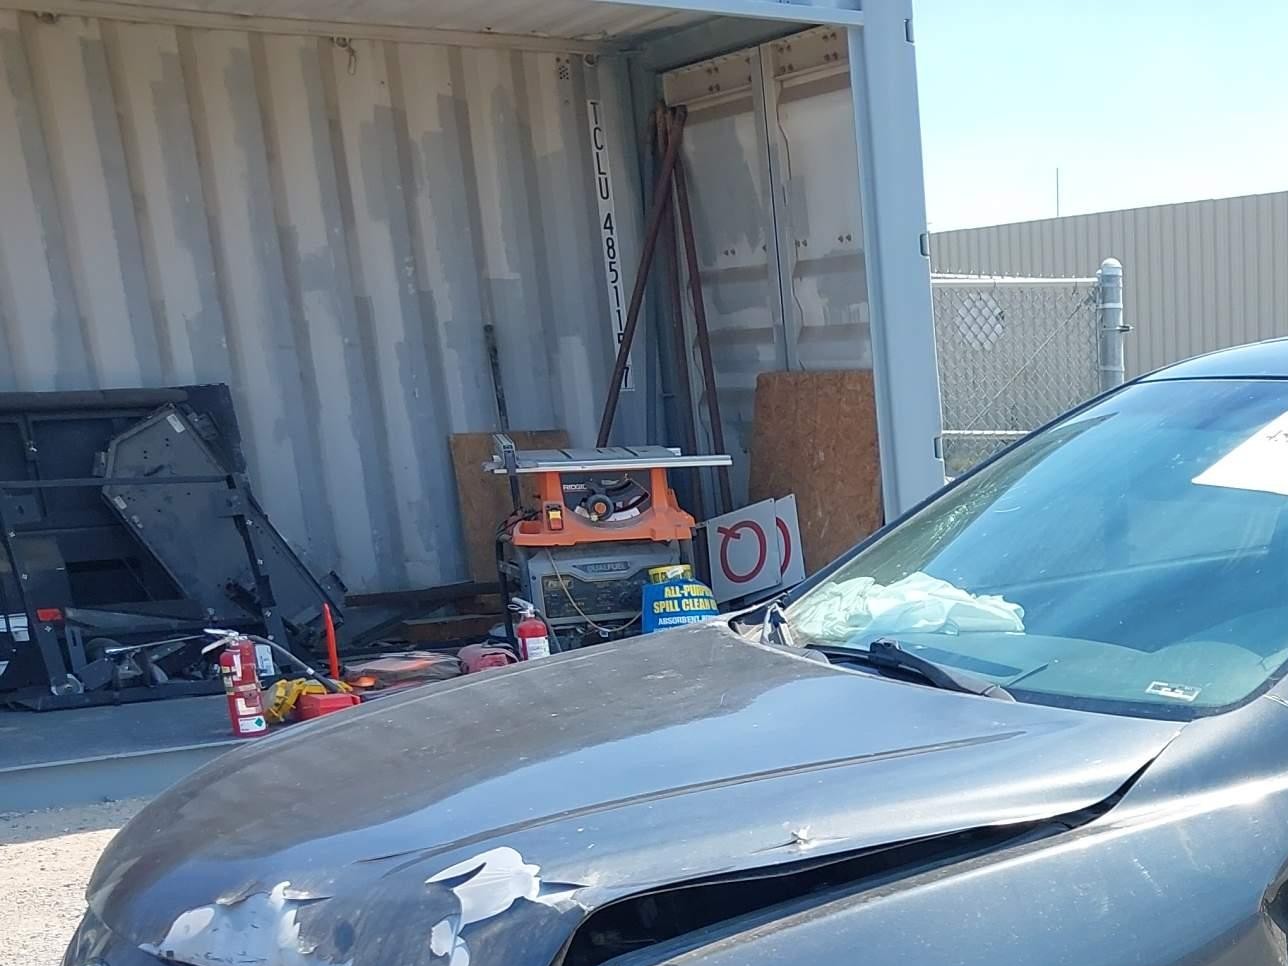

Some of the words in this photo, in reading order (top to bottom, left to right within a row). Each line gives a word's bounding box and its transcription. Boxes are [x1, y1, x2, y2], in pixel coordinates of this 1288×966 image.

[589, 101, 610, 200] TCLU
[653, 600, 680, 614] SPILL
[682, 598, 710, 611] CLEAN
